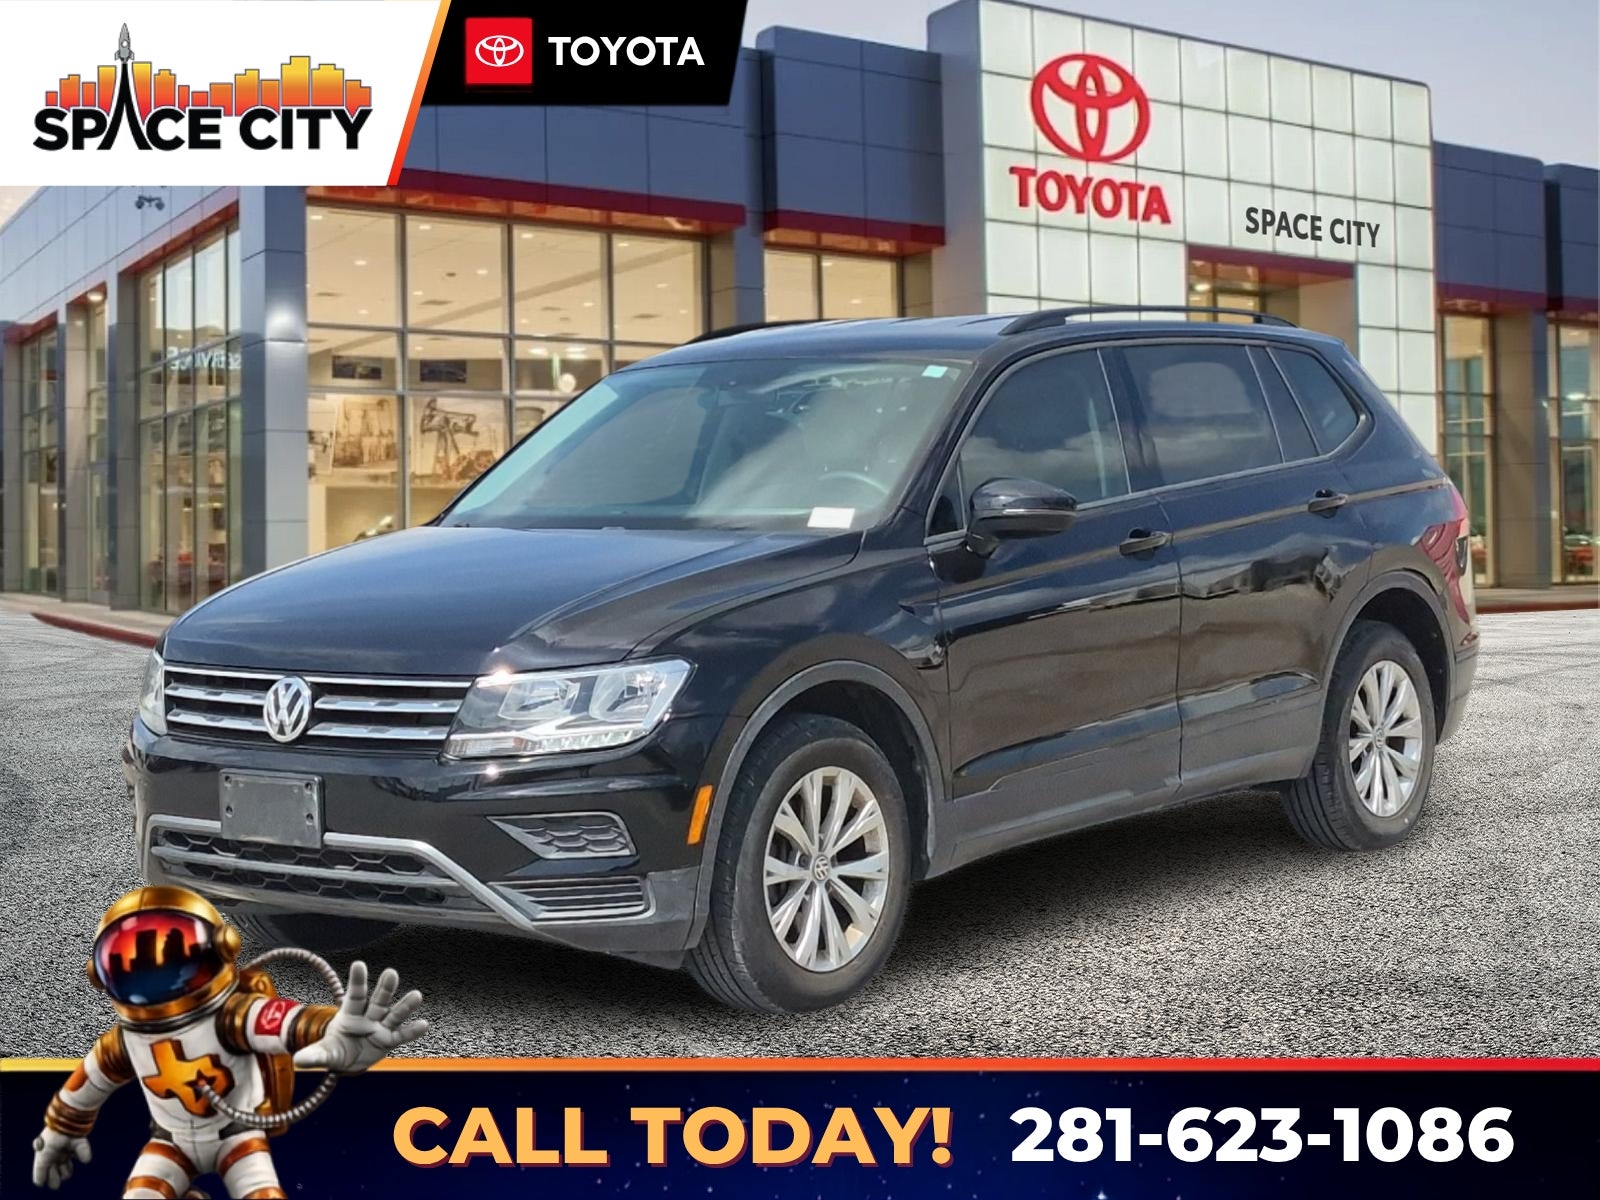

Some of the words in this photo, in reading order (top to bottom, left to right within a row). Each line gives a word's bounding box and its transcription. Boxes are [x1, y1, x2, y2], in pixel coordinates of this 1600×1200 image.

[1009, 165, 1171, 225] TOYOTA
[1245, 206, 1323, 242] SPACE
[1329, 217, 1380, 248] CITY
